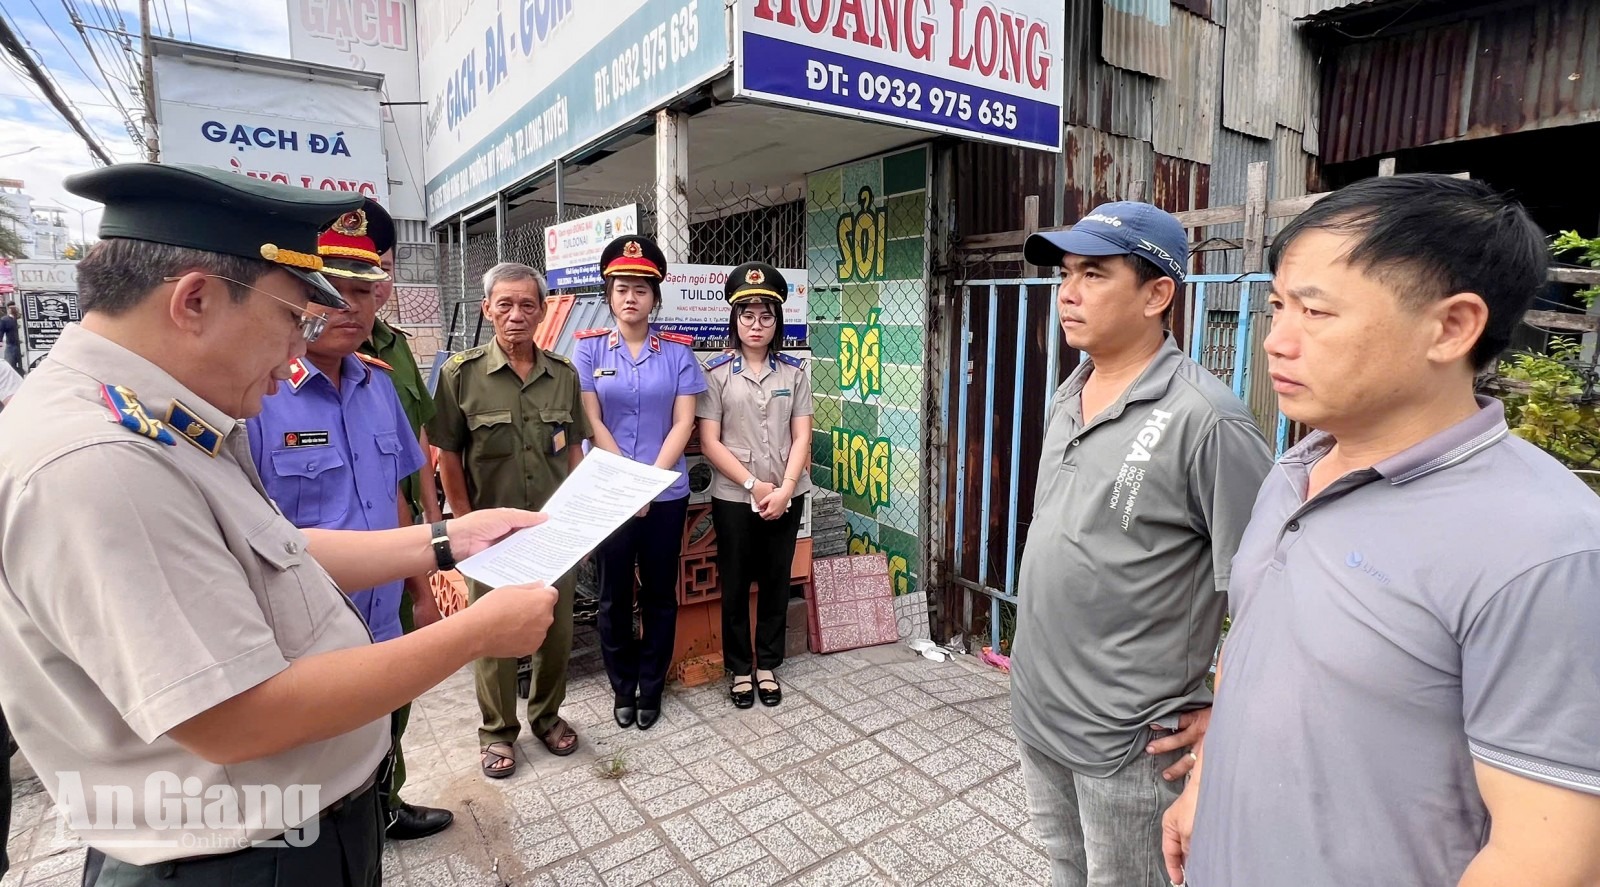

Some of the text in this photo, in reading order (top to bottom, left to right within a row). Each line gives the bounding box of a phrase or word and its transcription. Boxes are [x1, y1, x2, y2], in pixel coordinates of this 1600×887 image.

[595, 0, 699, 112] ĐT: 0932 975 635
[949, 0, 1050, 91] LONG
[806, 60, 1018, 130] ĐT: 0932 975 635
[201, 121, 351, 157] GẠCH ĐÁ
[524, 115, 543, 156] LONG
[543, 93, 569, 144] XUYÊN
[837, 187, 887, 282] SỎI
[665, 272, 687, 285] Gạch
[838, 309, 881, 402] ĐÁ
[1125, 408, 1173, 462] HGA
[831, 427, 890, 512] HOA
[1109, 462, 1129, 509] ASSOCIATION
[1125, 466, 1137, 487] GOLF
[1130, 481, 1141, 498] CHI
[1135, 468, 1146, 482] HO
[1123, 496, 1136, 516] MINH
